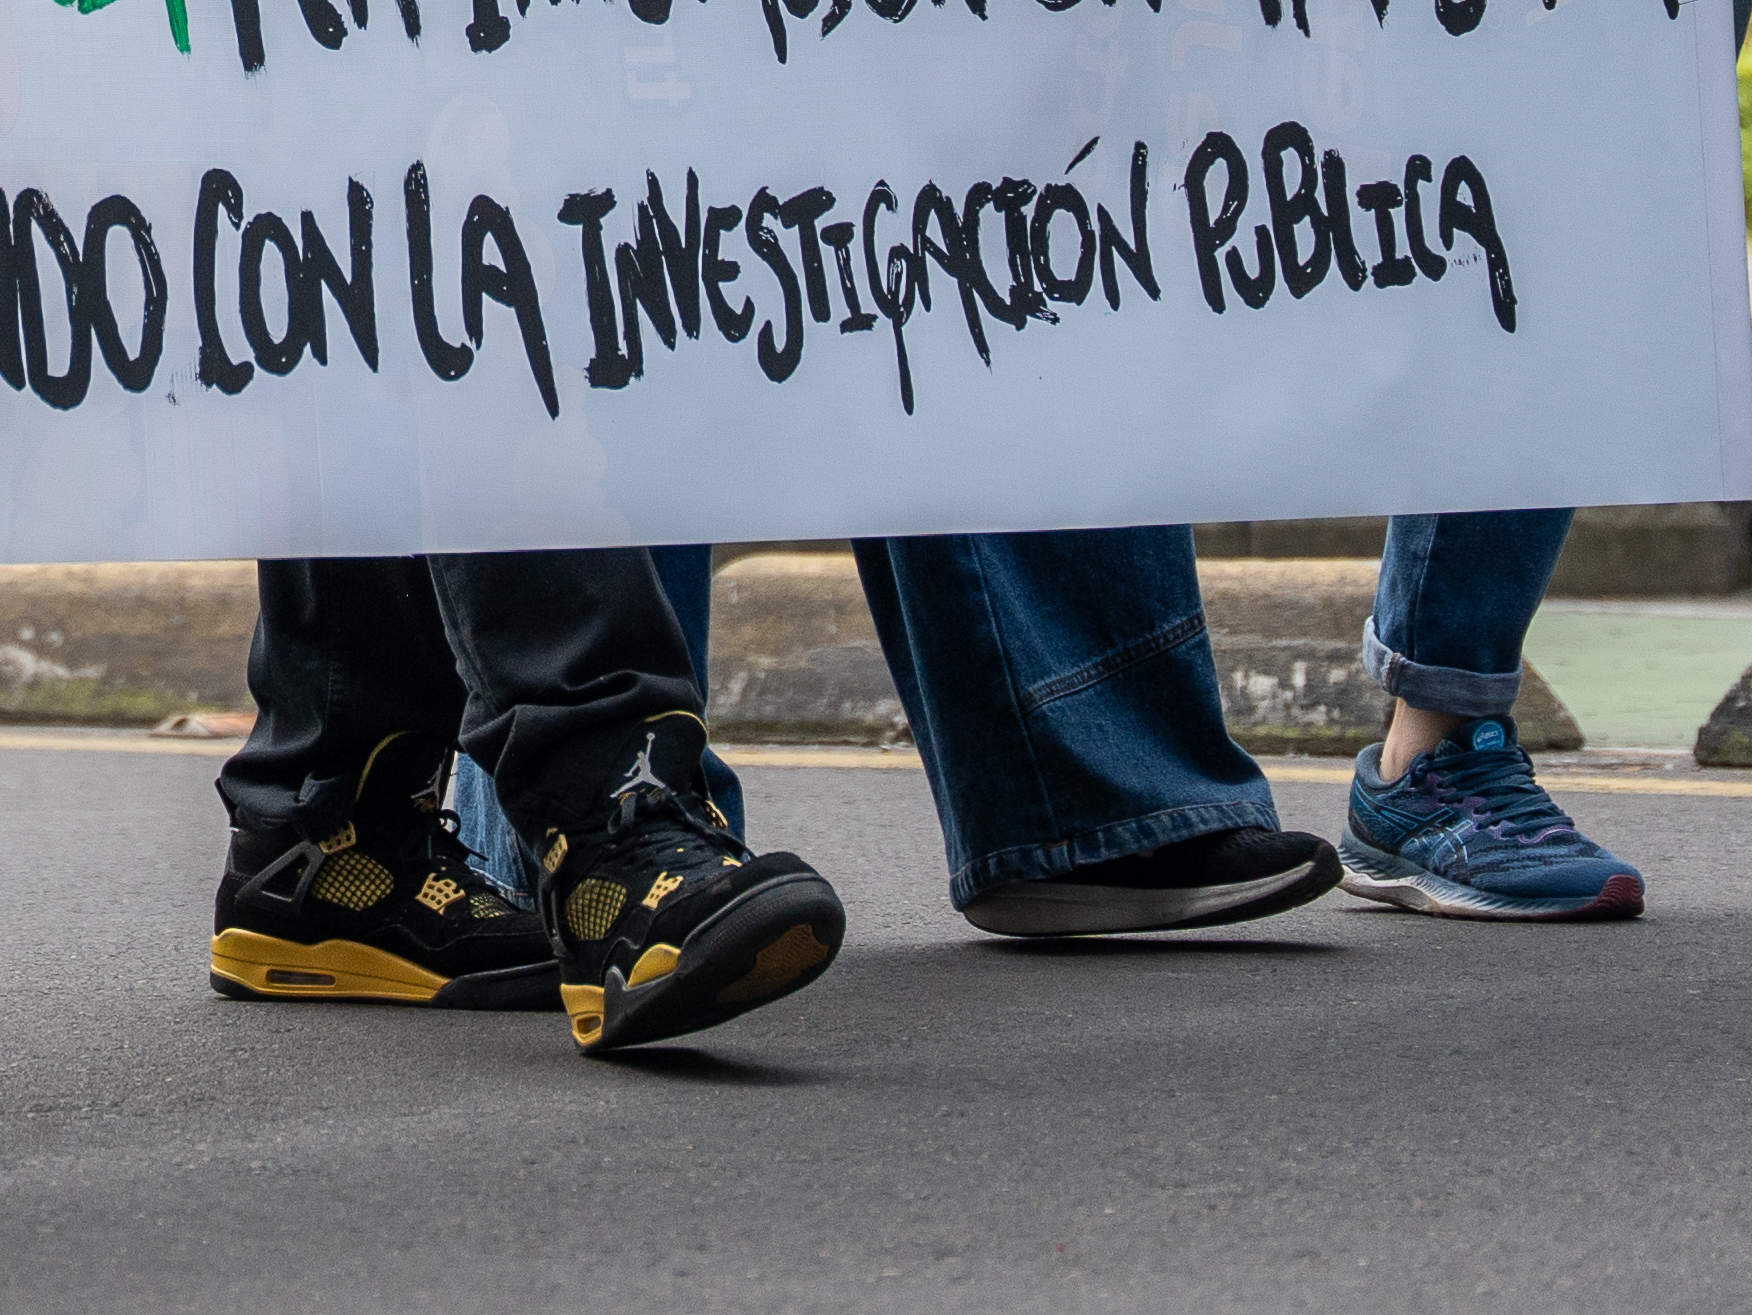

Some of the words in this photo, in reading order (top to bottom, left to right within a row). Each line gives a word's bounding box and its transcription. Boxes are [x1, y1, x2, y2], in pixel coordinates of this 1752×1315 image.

[191, 167, 381, 396] CON
[403, 158, 561, 422] LA
[556, 135, 1162, 417] INVESTIGACIÓN
